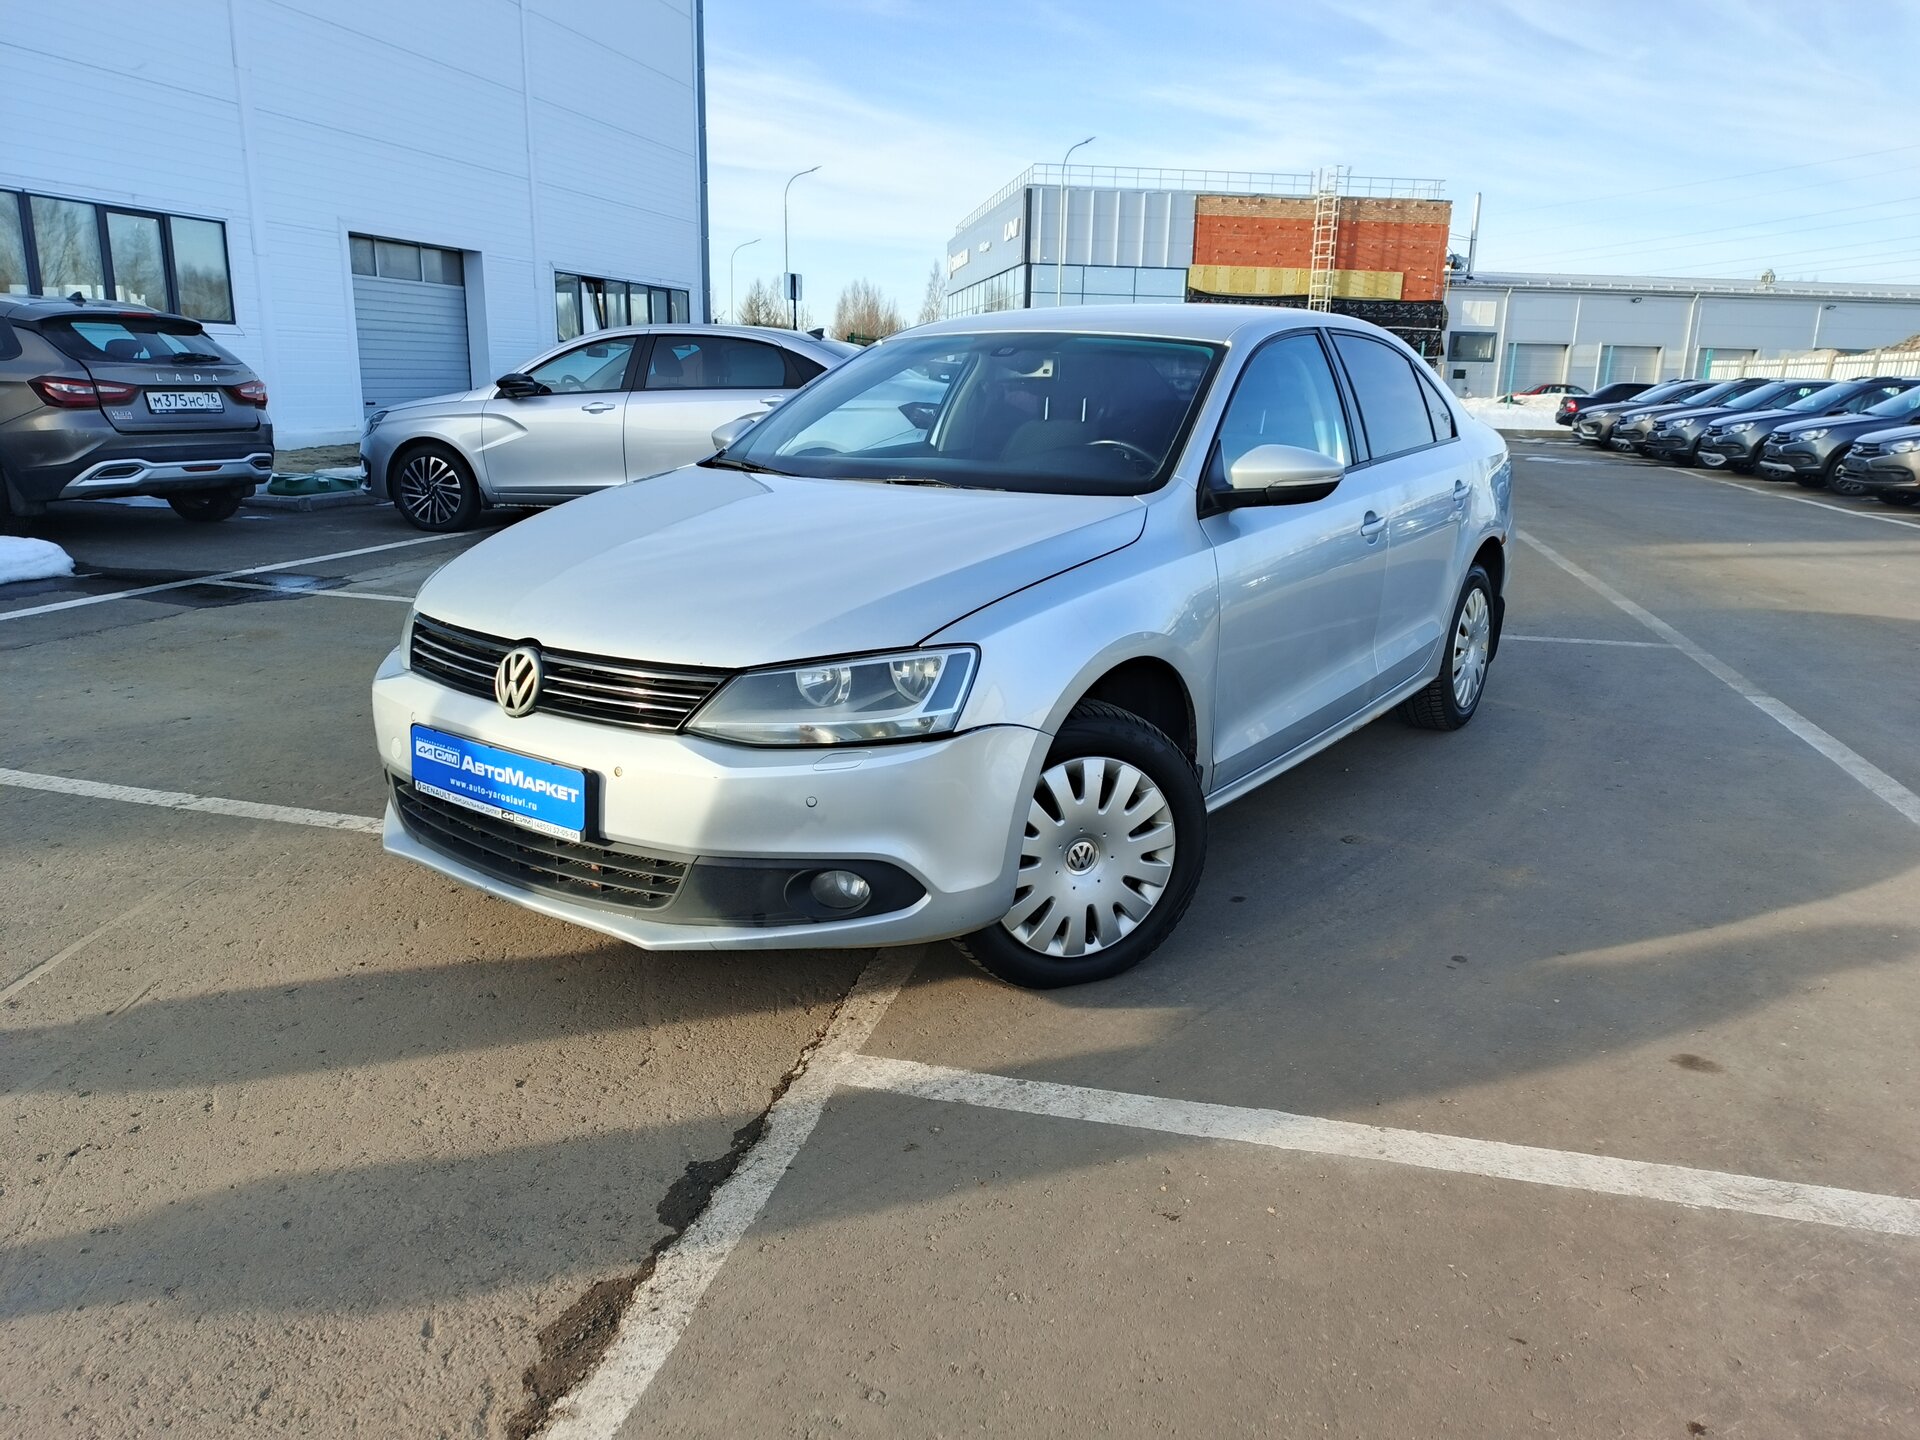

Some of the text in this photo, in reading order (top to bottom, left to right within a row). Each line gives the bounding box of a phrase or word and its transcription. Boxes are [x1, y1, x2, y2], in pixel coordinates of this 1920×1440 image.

[155, 373, 218, 382] LADA
[436, 751, 459, 767] СИМ
[421, 784, 452, 801] RENAULT
[449, 777, 538, 811] www.auto-yaroslavl.ru
